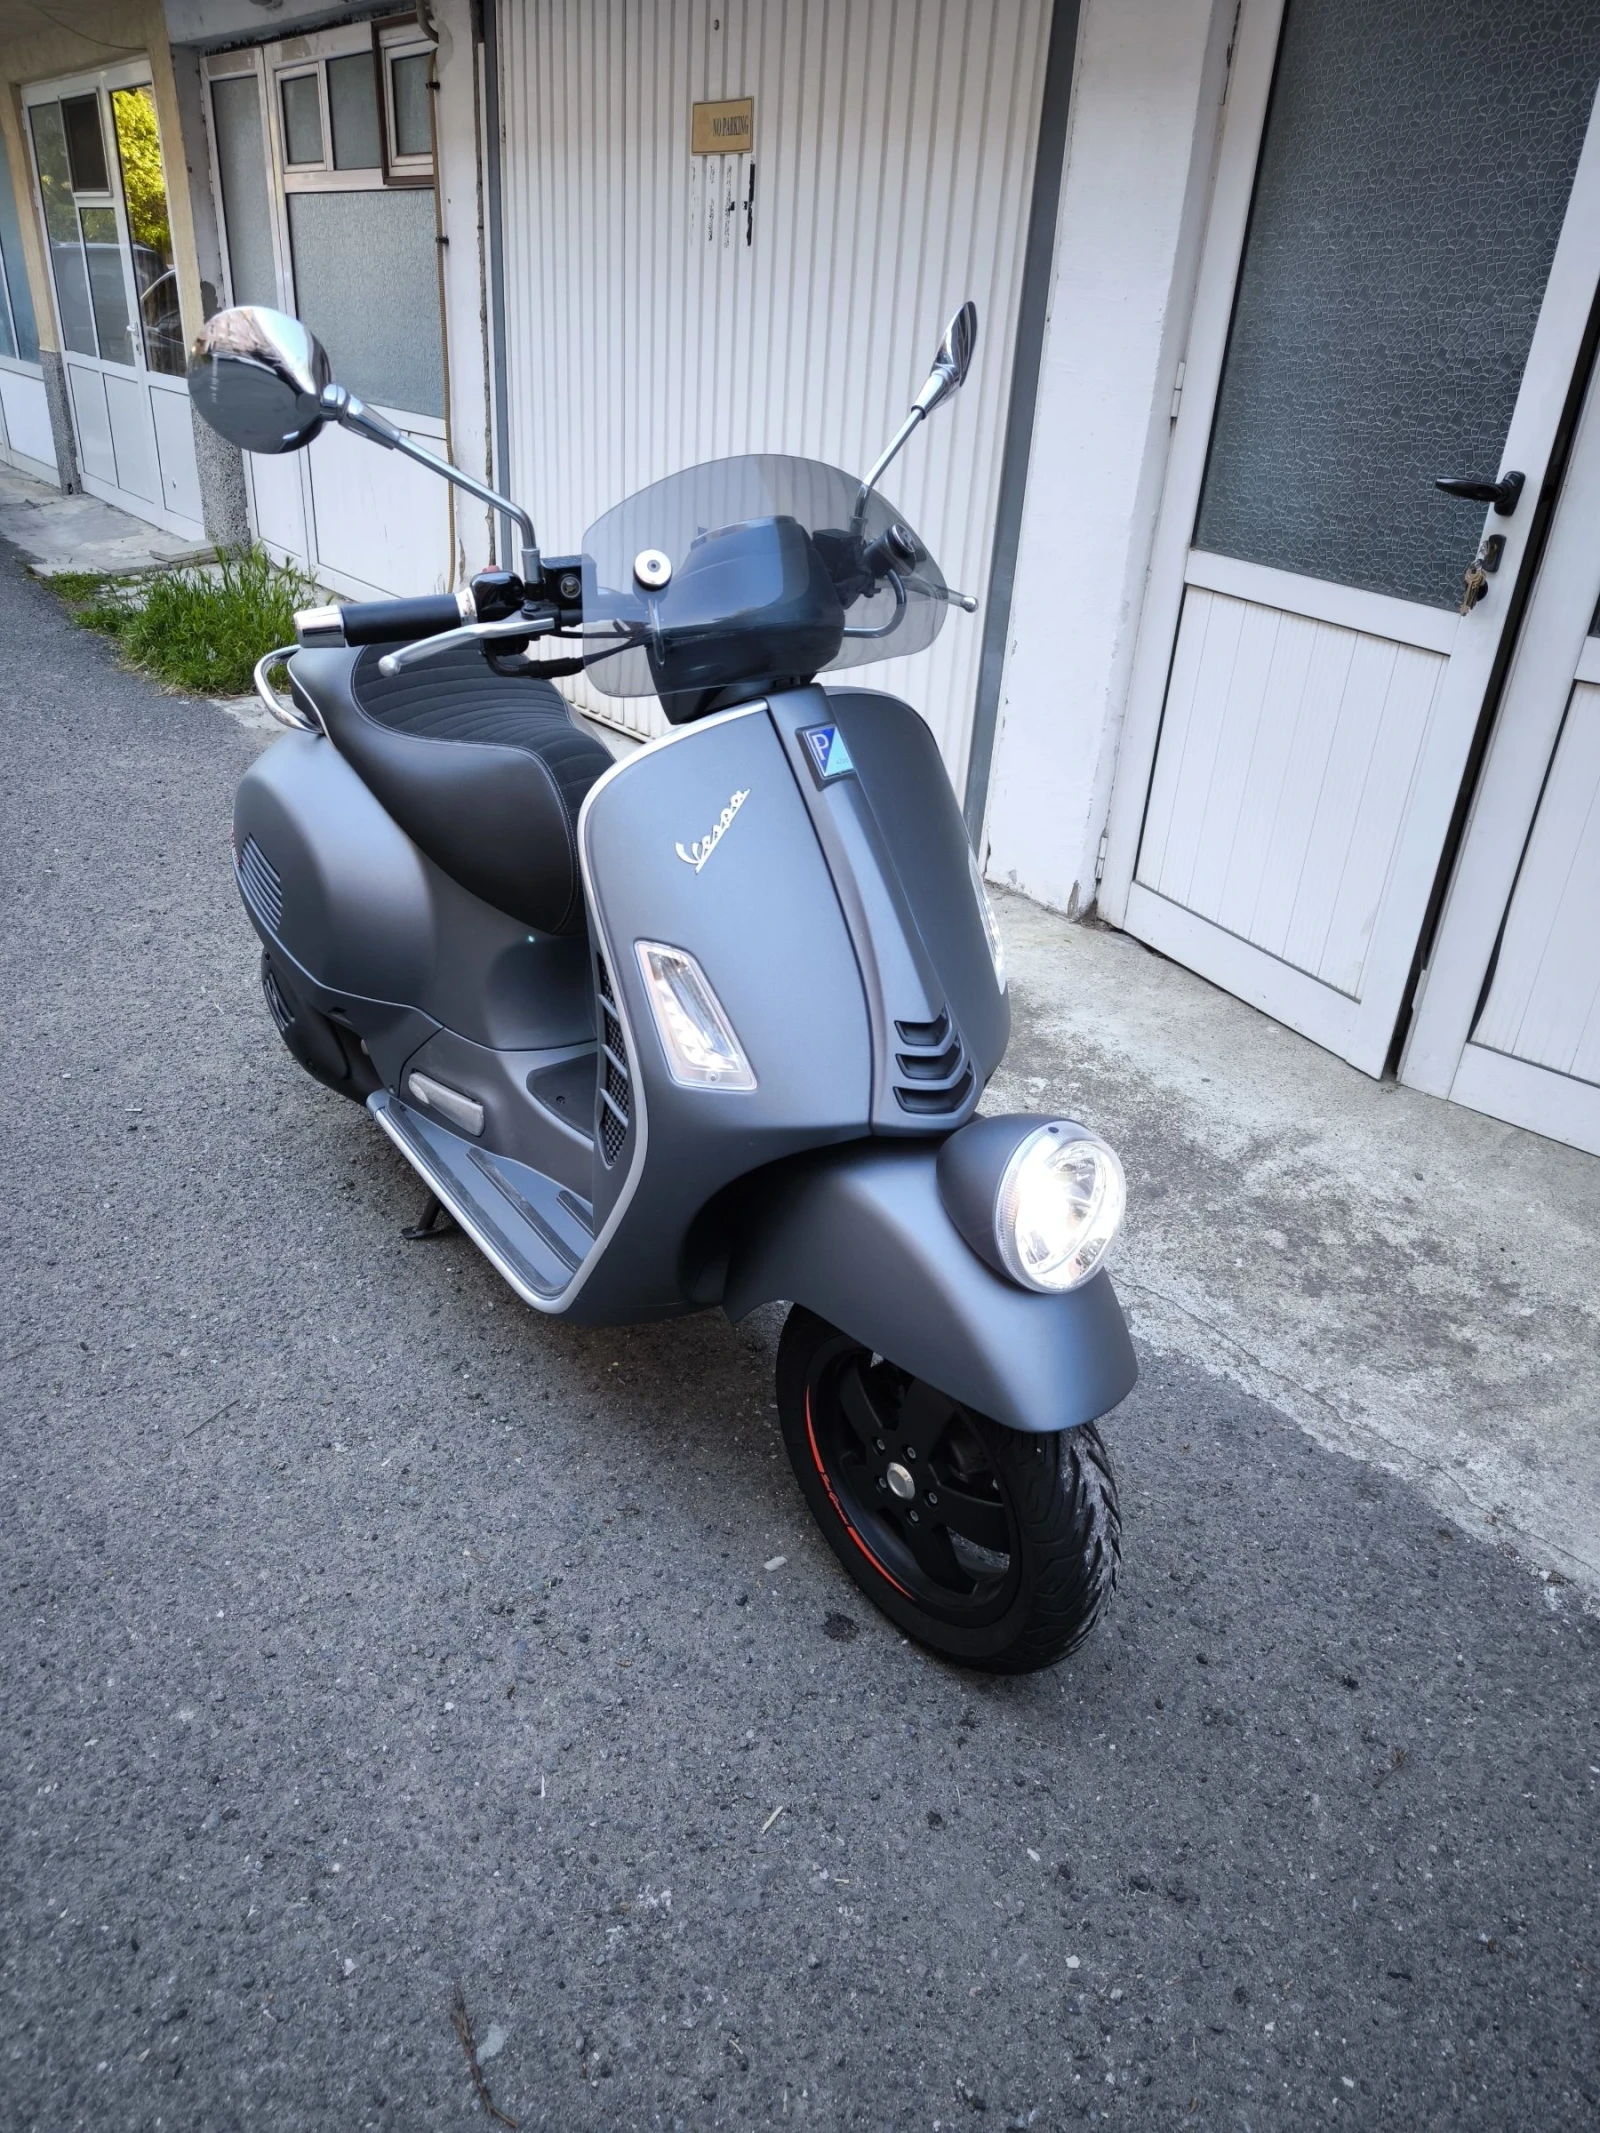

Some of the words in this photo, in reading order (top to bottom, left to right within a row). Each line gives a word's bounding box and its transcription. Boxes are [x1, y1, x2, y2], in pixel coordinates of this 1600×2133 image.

[712, 117, 722, 137] NO
[722, 115, 749, 137] PARKING
[811, 733, 830, 761] P
[675, 788, 751, 875] Vespa
